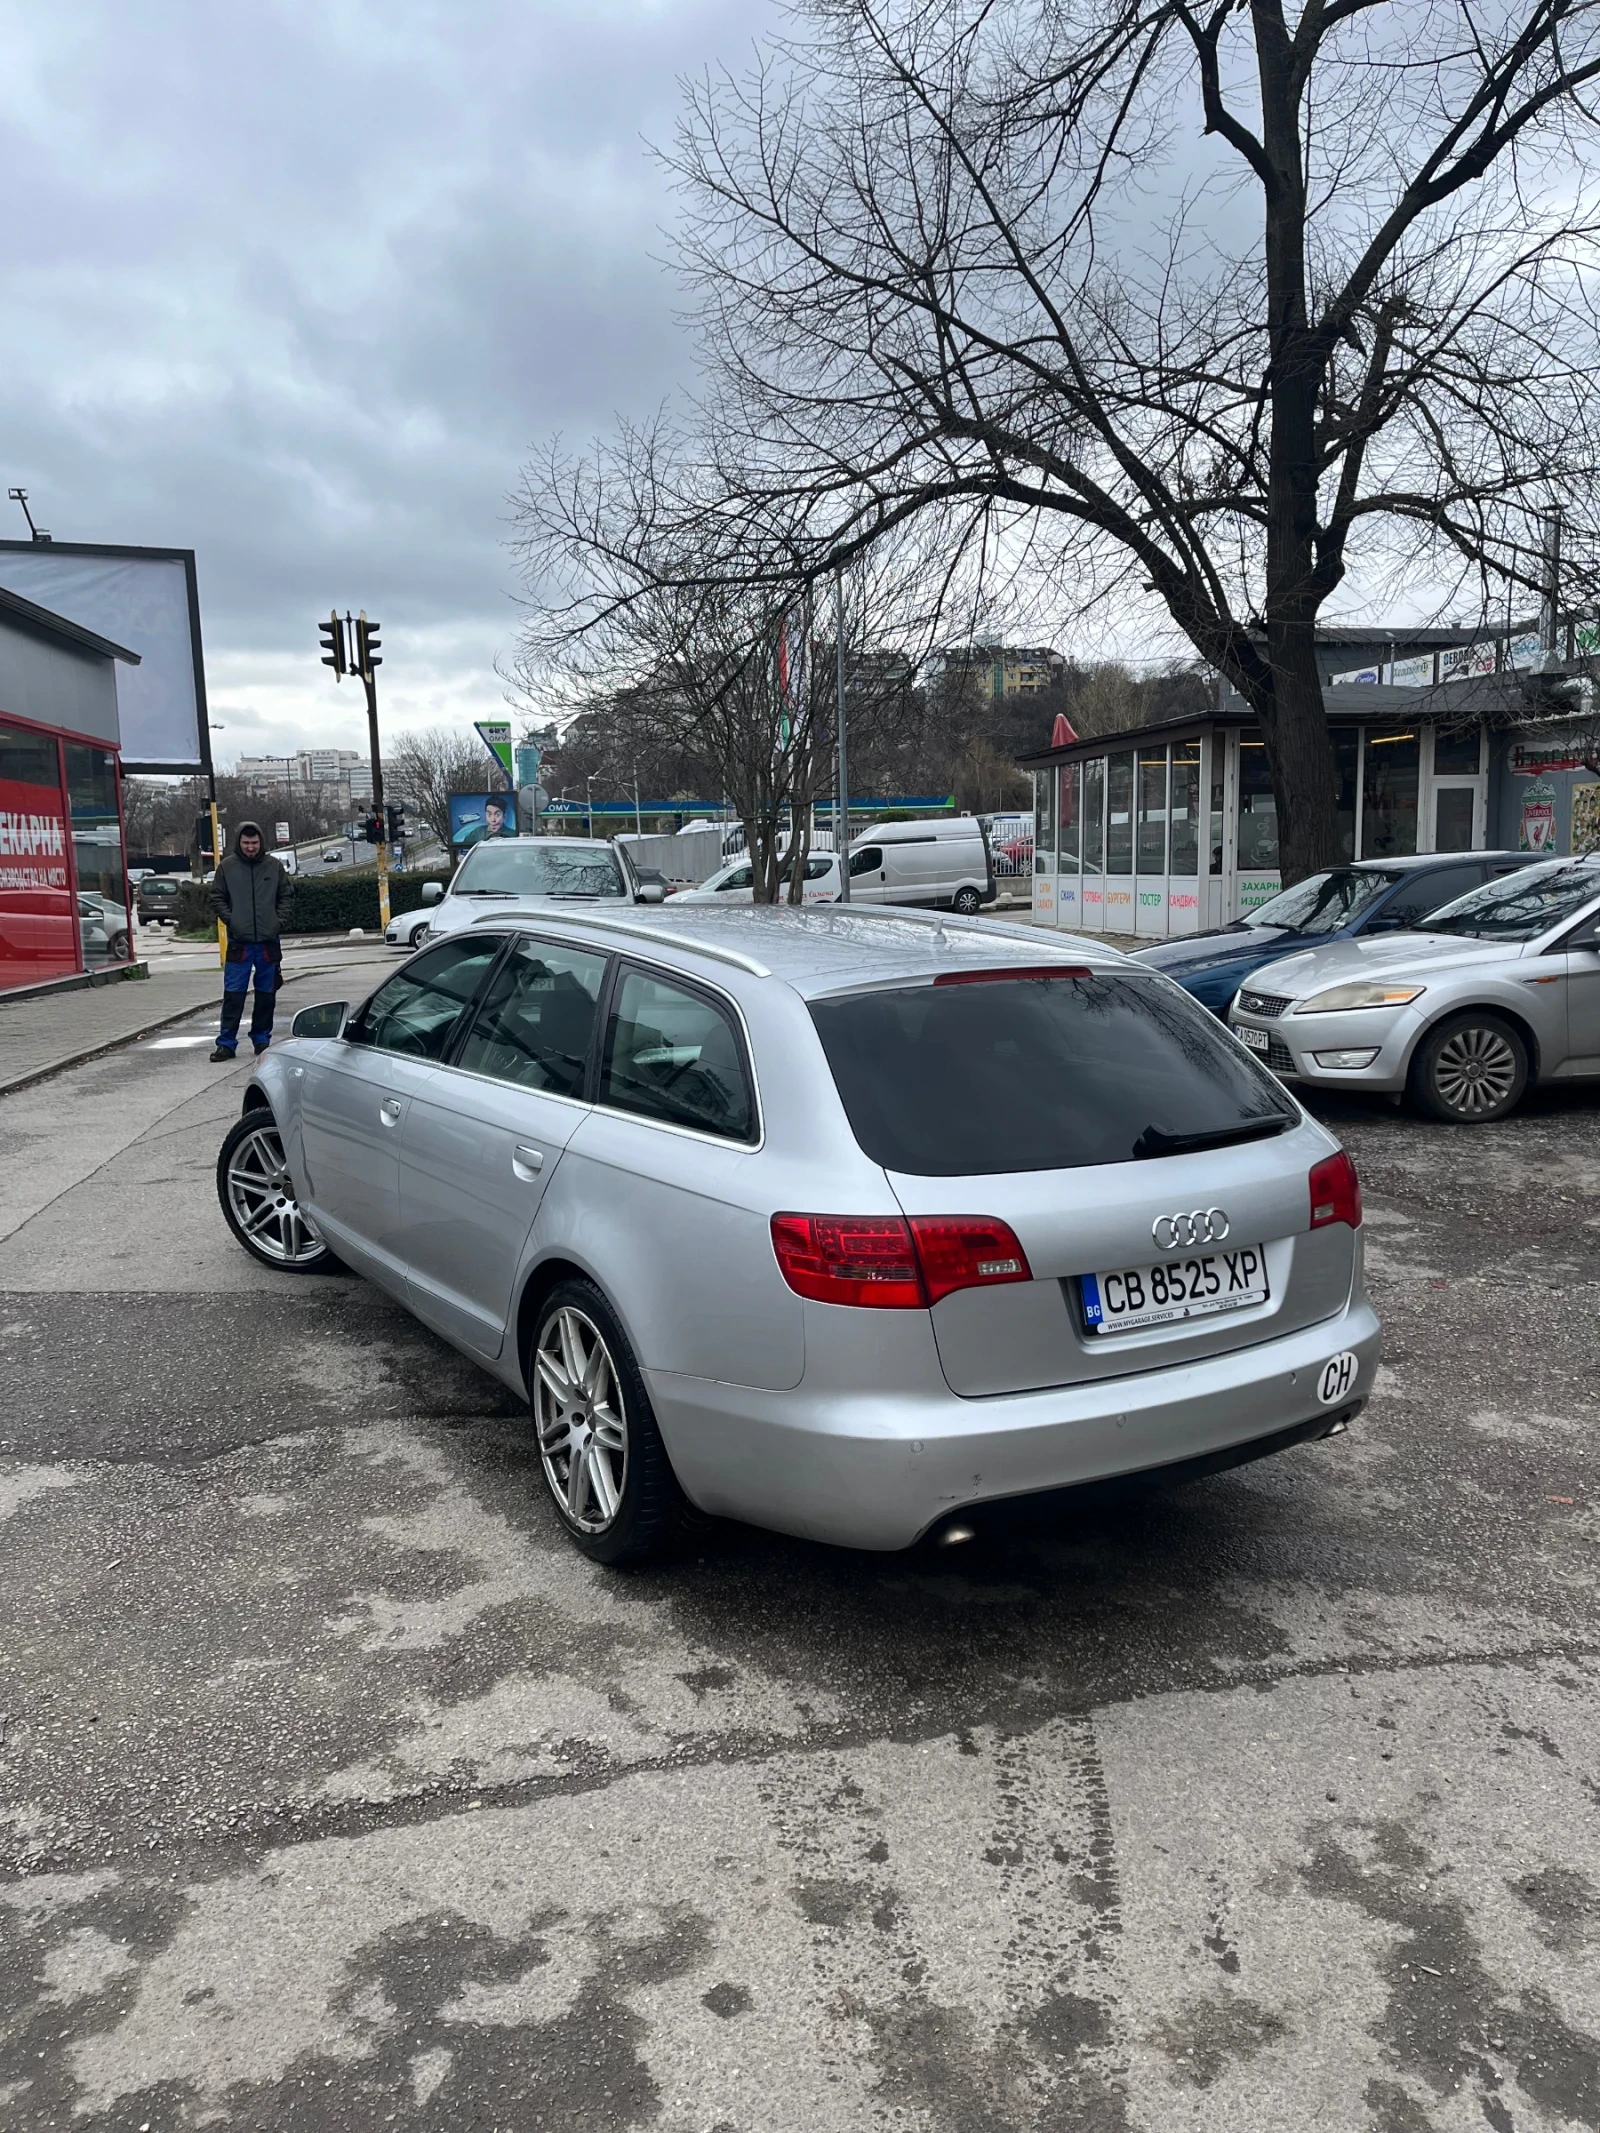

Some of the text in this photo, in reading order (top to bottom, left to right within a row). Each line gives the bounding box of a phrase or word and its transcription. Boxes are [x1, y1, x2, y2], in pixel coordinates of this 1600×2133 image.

[548, 804, 570, 812] OMV
[1526, 809, 1551, 817] LIVERPOOL
[1060, 889, 1075, 902] СКАРА
[1107, 891, 1131, 905] БУРГЕРИ
[1139, 893, 1162, 906] ТОСТЕР
[1259, 1033, 1267, 1047] PT
[1087, 1250, 1258, 1318] BG CB 8525 XP
[1107, 1311, 1174, 1330] WWW.MYGARAGE.SERVICES
[1323, 1355, 1352, 1401] CH
